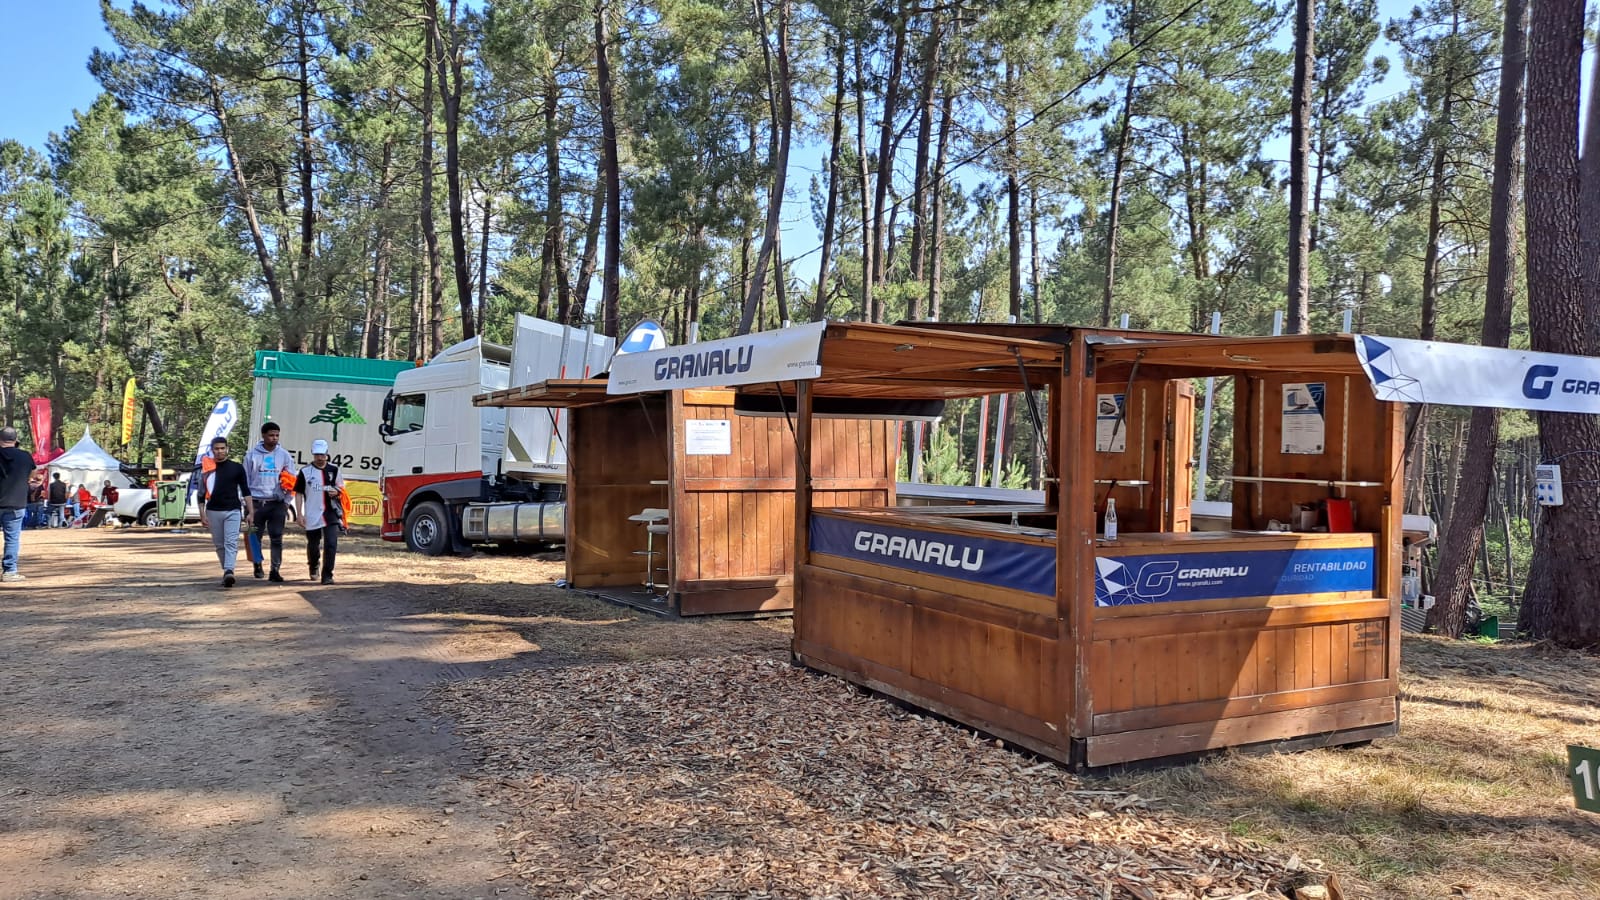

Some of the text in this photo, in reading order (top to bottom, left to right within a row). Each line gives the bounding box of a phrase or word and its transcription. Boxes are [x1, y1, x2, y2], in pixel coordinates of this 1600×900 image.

[654, 345, 754, 381] GRANALU
[1561, 379, 1600, 395] GRA
[326, 453, 354, 468] 42
[359, 456, 382, 470] 59
[854, 530, 984, 571] GRANALU
[1177, 566, 1249, 579] GRANALU
[1293, 561, 1367, 573] RENTABILIDAD
[1574, 759, 1600, 800] 1
